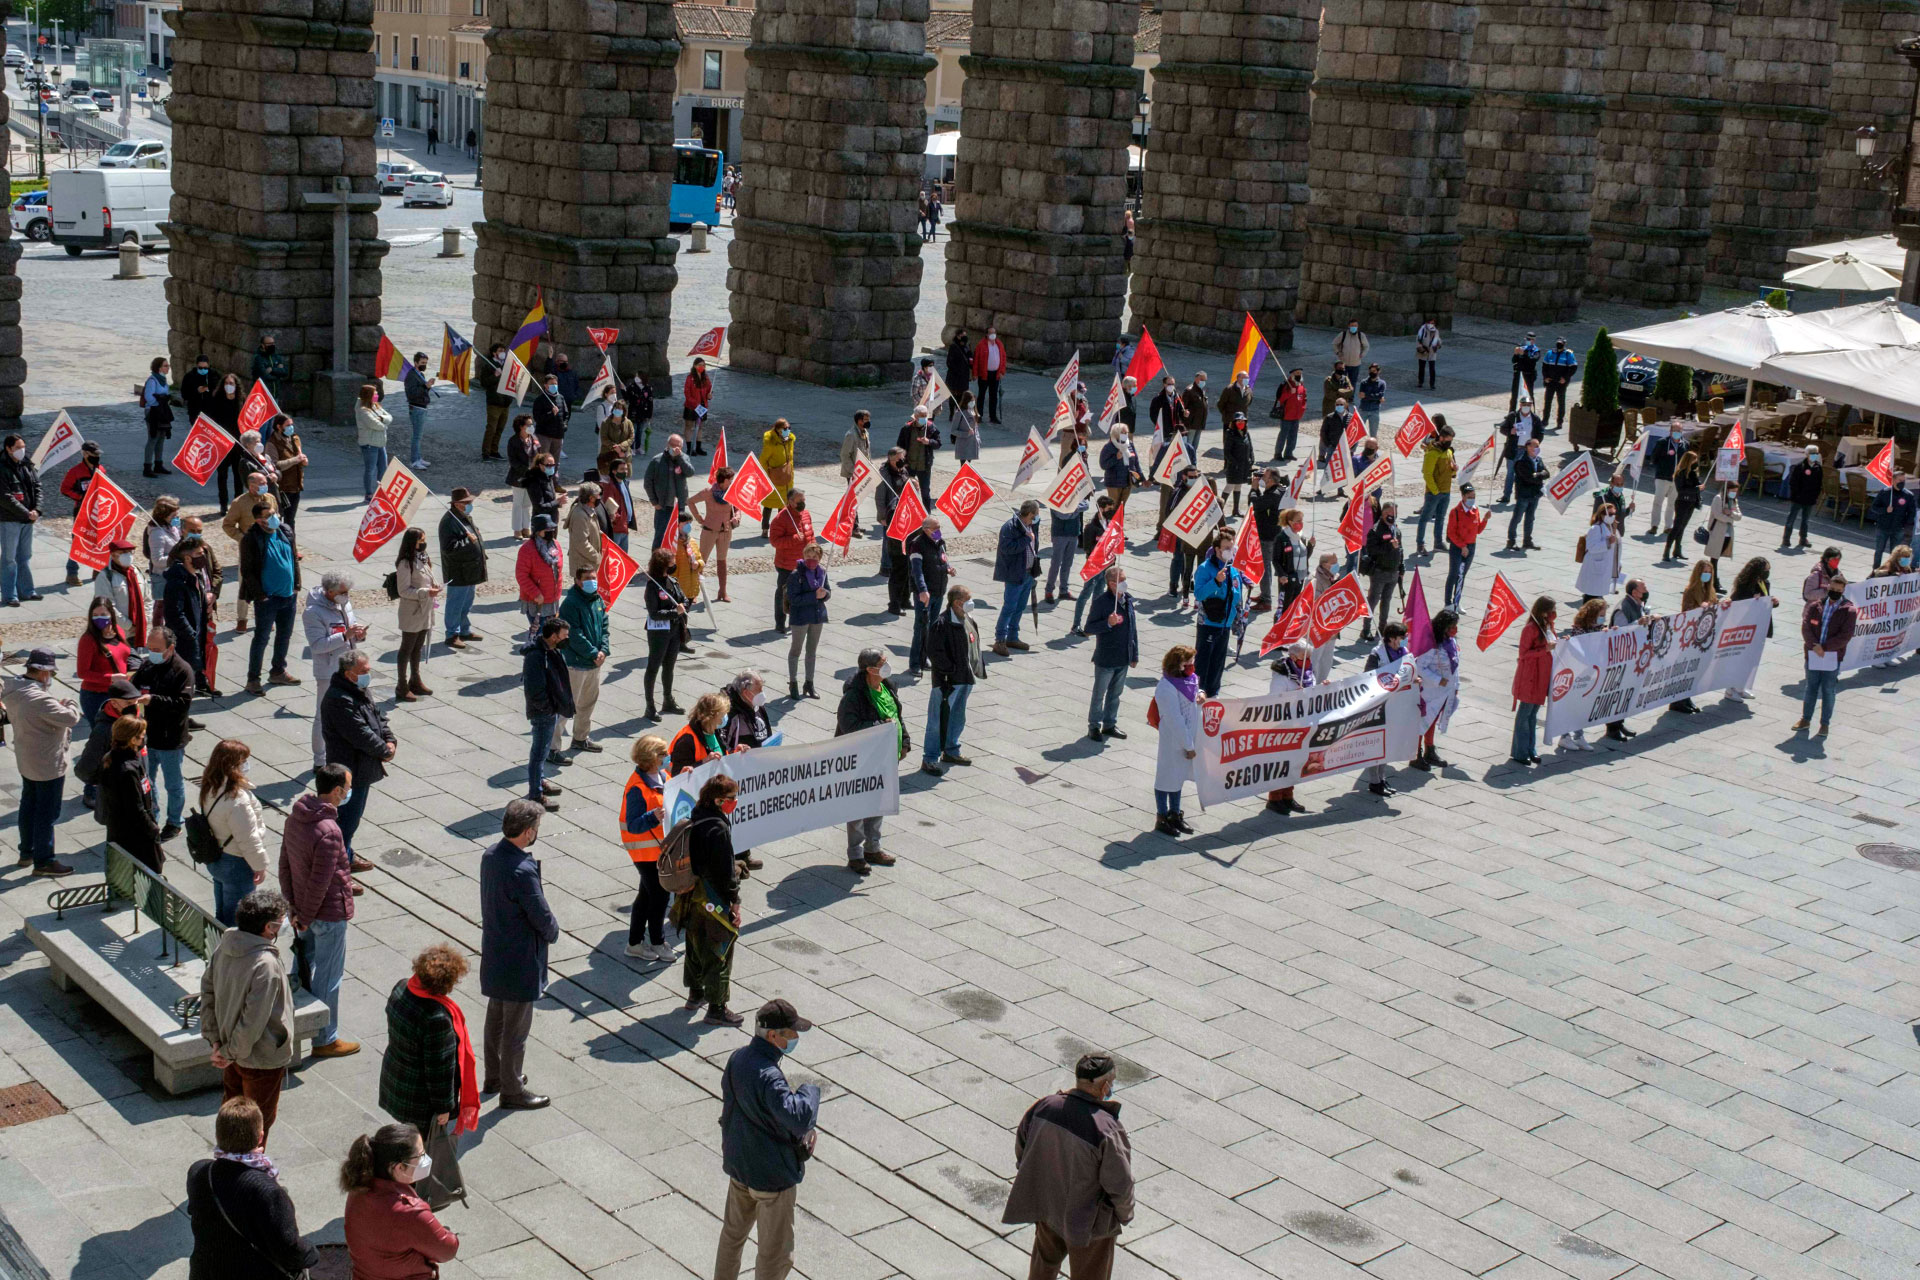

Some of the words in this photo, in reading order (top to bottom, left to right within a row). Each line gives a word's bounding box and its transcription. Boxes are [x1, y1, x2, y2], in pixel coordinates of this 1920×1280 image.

[712, 98, 744, 108] BURGE
[1403, 416, 1419, 437] UGT
[186, 438, 206, 467] UGT
[953, 480, 975, 504] UGT
[1051, 466, 1085, 506] CCOO
[1553, 463, 1588, 499] CCOO
[1178, 489, 1213, 531] CCOO
[1318, 591, 1352, 620] UGT
[1866, 586, 1878, 600] LAS
[1895, 597, 1920, 614] TURIS
[1722, 628, 1753, 644] CCOO
[1853, 620, 1891, 636] DONADAS
[1608, 632, 1638, 666] AHORA
[1554, 674, 1573, 687] UGT
[1600, 664, 1626, 695] TOCA
[1203, 706, 1224, 721] UGT
[1240, 702, 1292, 722] AYUDA
[1296, 700, 1304, 718] A
[1588, 688, 1634, 722] CUMPLIR
[1223, 738, 1236, 758] NO
[1238, 733, 1253, 750] SE
[1258, 732, 1304, 748] VENDE
[1316, 726, 1336, 742] SE
[738, 772, 766, 796] IATIVA
[768, 768, 788, 788] POR
[790, 763, 812, 782] UNA
[814, 758, 834, 777] LEY
[836, 754, 858, 772] QUE
[1224, 760, 1290, 790] SEGOVIA
[748, 804, 759, 821] EL
[760, 790, 808, 816] DERECHO
[808, 788, 816, 804] A
[819, 784, 832, 802] LA
[834, 774, 884, 798] VIVIENDA
